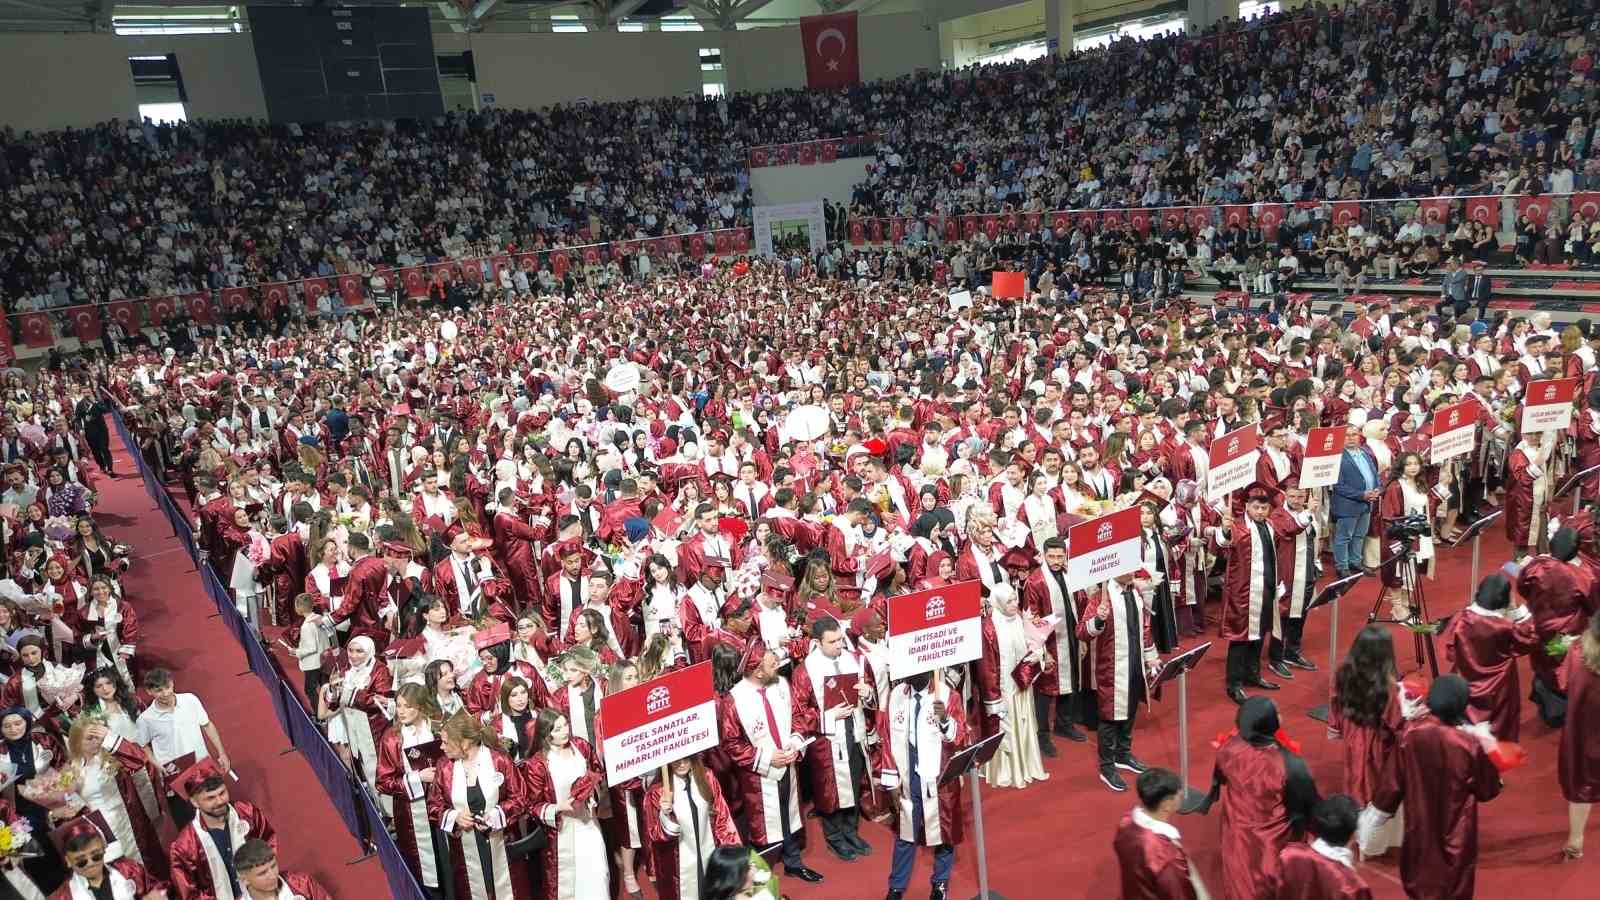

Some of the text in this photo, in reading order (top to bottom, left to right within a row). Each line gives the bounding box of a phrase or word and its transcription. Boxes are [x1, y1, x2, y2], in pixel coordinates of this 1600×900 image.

[914, 627, 958, 644] İKTİSADİ VE
[930, 635, 965, 650] BİLİMLER
[917, 647, 957, 664] FAKÜLTESİ
[621, 713, 700, 748] GÜZEL SANATLAR,
[635, 727, 689, 753] TASARIM VE
[615, 728, 710, 772] MİMARLIK FAKÜLTESİ
